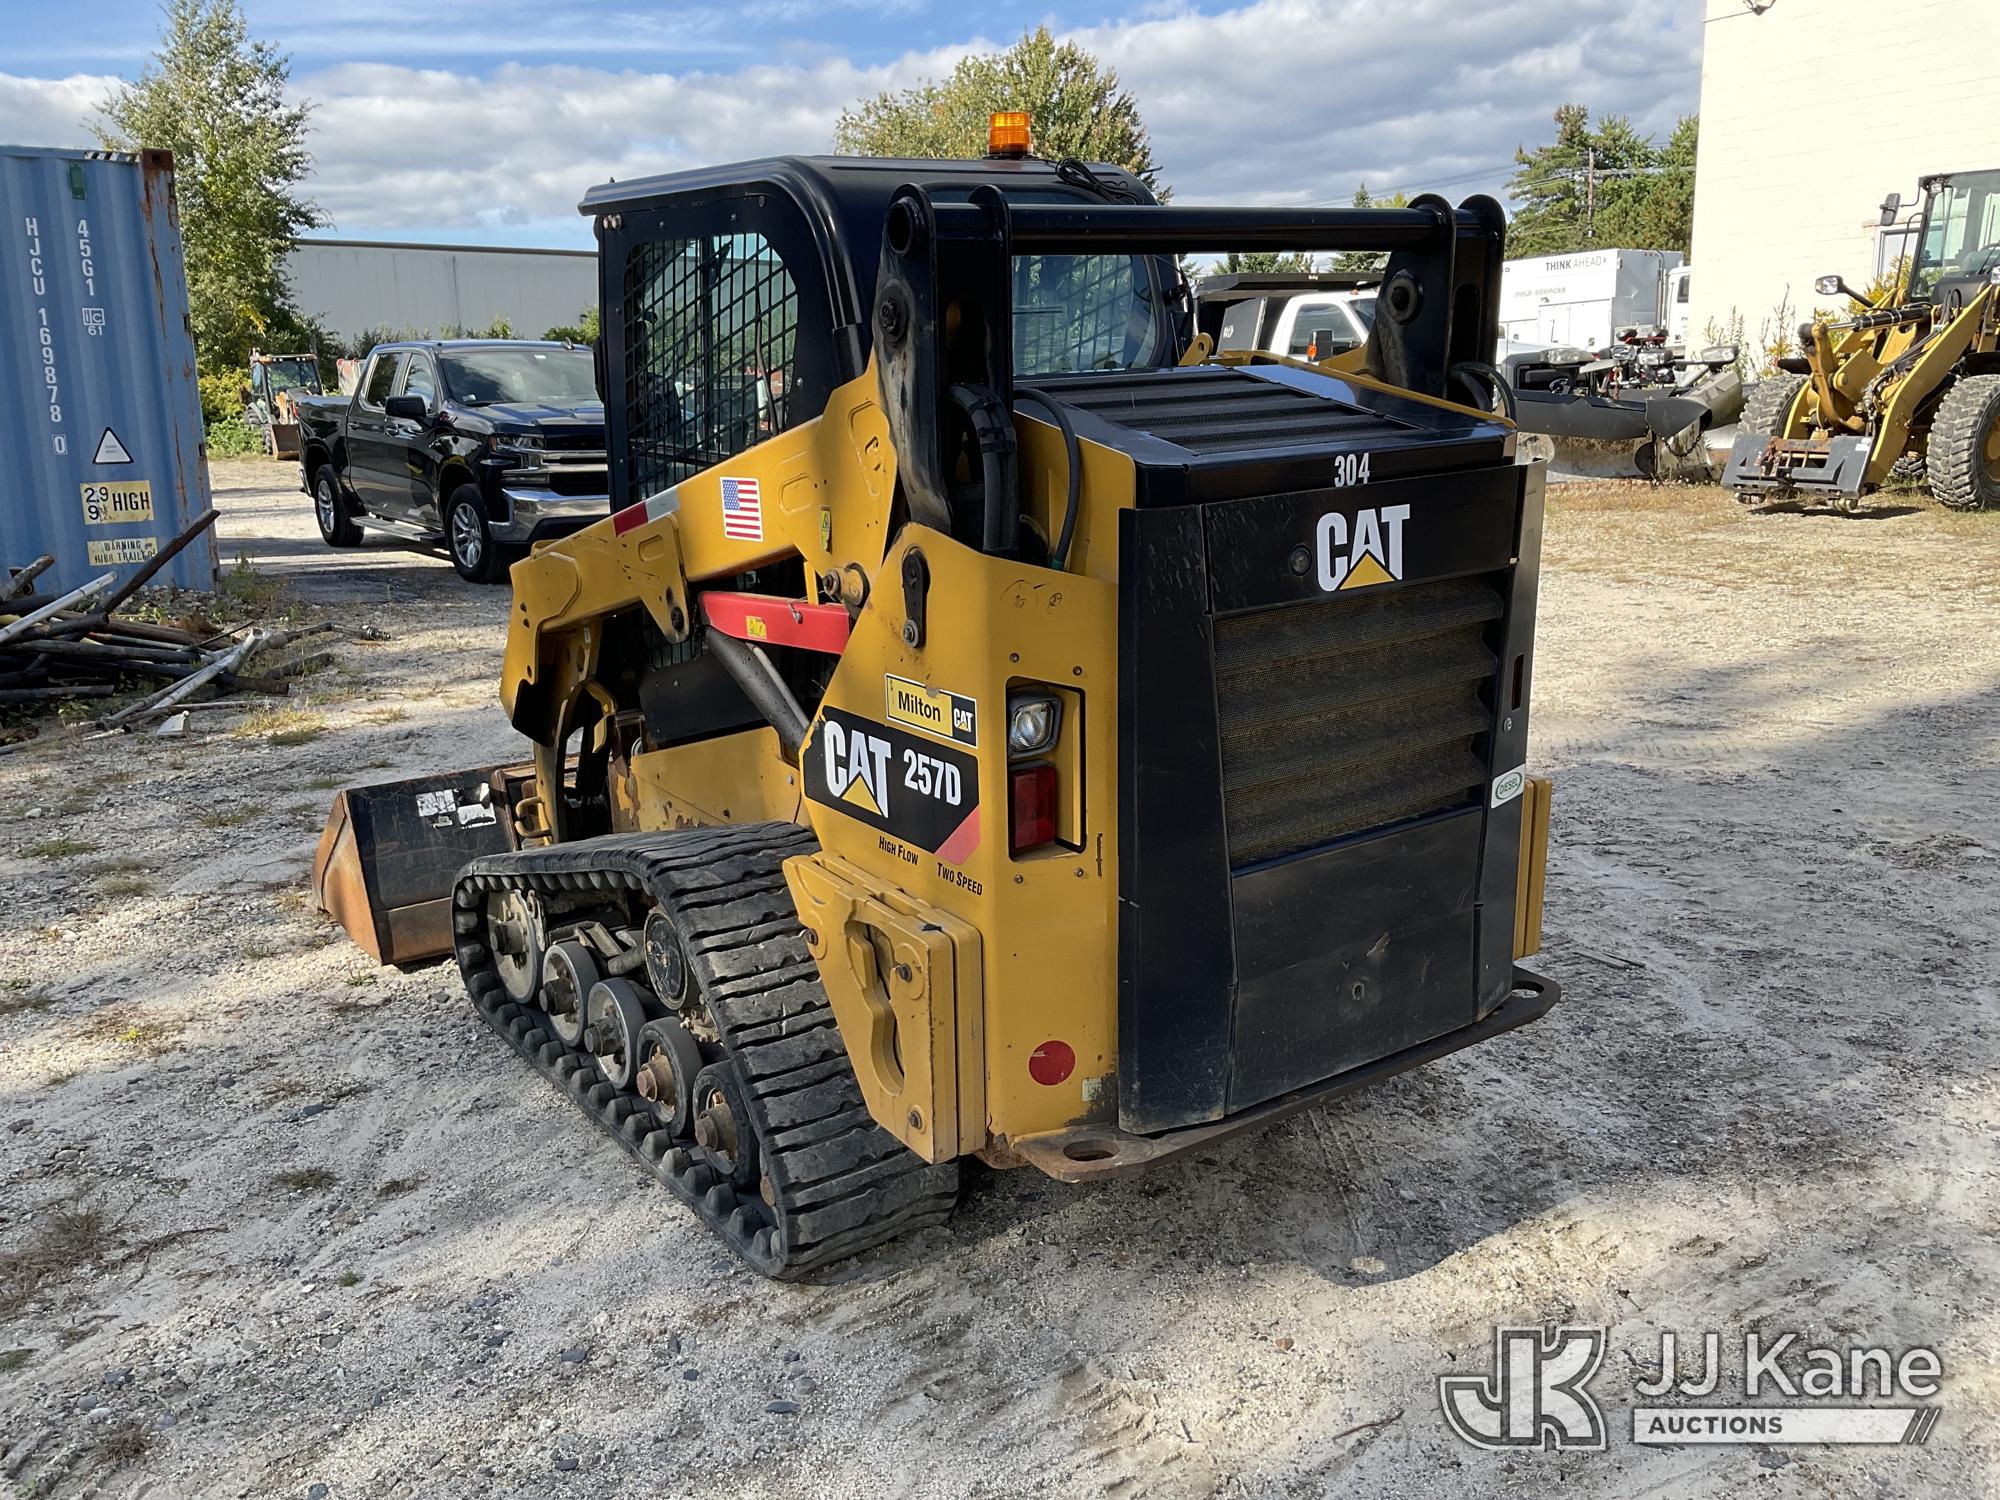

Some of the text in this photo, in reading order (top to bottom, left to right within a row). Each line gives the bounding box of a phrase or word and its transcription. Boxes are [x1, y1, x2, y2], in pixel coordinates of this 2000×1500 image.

[77, 219, 95, 296] 45G1
[1545, 259, 1572, 271] THINK
[25, 217, 46, 296] HJCU
[38, 307, 62, 422] 169878
[88, 325, 103, 336] 61
[1334, 452, 1370, 488] 304
[112, 491, 150, 511] HIGH
[104, 540, 141, 552] WARNING
[1316, 503, 1410, 592] CAT
[898, 690, 974, 733] Milton CAT
[823, 720, 961, 818] CAT 257D
